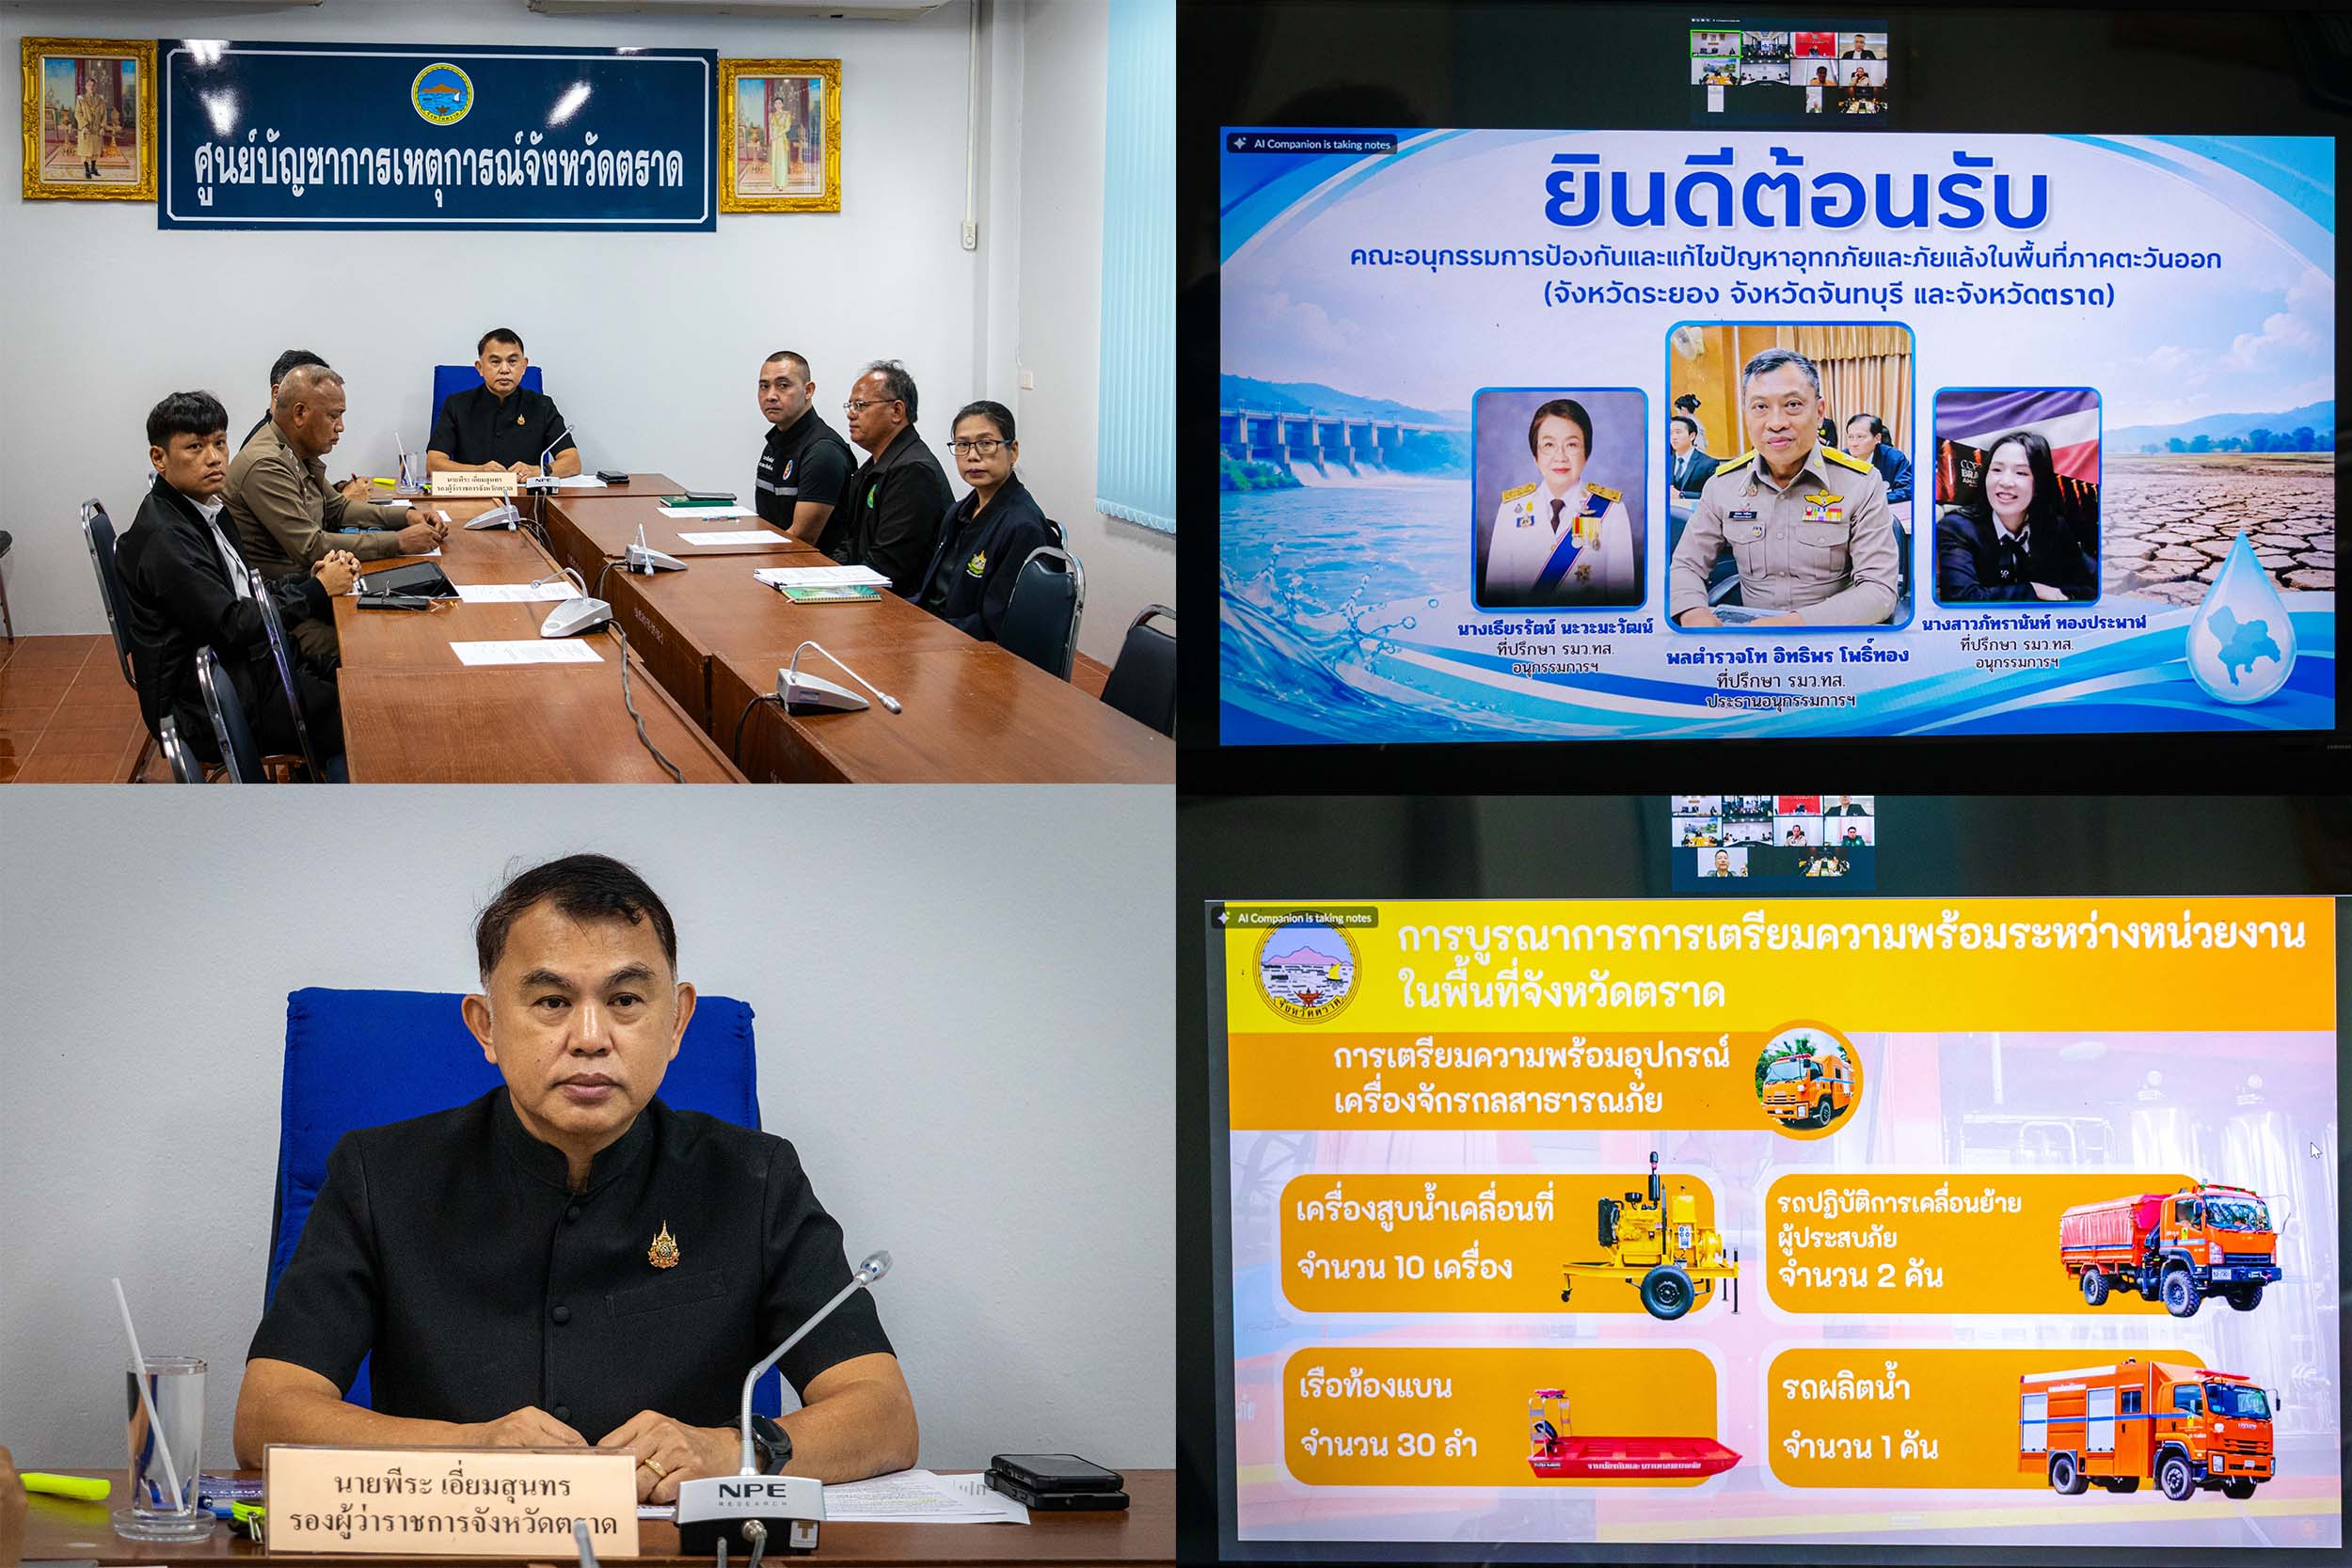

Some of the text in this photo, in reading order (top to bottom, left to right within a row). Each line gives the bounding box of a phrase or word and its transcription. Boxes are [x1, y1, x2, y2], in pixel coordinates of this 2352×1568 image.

[1254, 138, 1391, 152] AI Companion is taking notes
[195, 128, 682, 207] ศูนย์บัญชาการเหตุการณ์จังหวัดตราด
[1545, 147, 2049, 229] ยินดีต้อนรับ
[1351, 241, 2222, 275] คณะอนุกรรมการป้องกันและแก้ไขปัญหาอุทกภัยและภัยแล้งในพื้นที่ภาคตะวันออก
[1544, 280, 2115, 312] (จังหวัดระยอง จังหวัดจันทบุรี และจังหวัดตราด)
[1457, 617, 1654, 636] นางเธียรรัตน์ นะวะมะวัฒน์
[1922, 613, 2052, 631] นางสาวภัทรานันท์
[1496, 641, 1615, 657] ที่ปรึกษา รมว.ทส.
[1666, 638, 1909, 665] พลตำรวจโท อิทธิพร โพธิ์ทอง
[1961, 635, 2074, 651] ที่ปรึกษา รมว.ทส.
[1513, 660, 1598, 677] อนุกรรมการฯ
[1716, 669, 1846, 689] ที่ปรึกษา รมว.ทส.
[1976, 657, 2059, 673] อนุกรรมการฯ
[1707, 694, 1856, 713] ประธานอนุกรรมการฯ
[1237, 913, 1372, 925] AI Companion is taking notes
[1398, 911, 2306, 966] การบูรณาการการเตรียมความพร้อมระหว่างหน่วยงาน
[1398, 956, 1725, 1008] ในพื้นที่จังหวัดตราด
[1334, 1035, 1729, 1079] การเตรียมความพร้อมอุปกรณ์
[1335, 1074, 1663, 1114] เครื่องจักรกลสาธารณภัย
[1296, 1181, 1554, 1232] เครื่องสูบน้ำเคลื่อนที่
[1777, 1181, 2022, 1219] รถปฏิบัติการเคลื่อนย้าย
[1777, 1223, 1898, 1256] ผู้ประสบภัย
[1297, 1240, 1513, 1280] จำนวน 10 เครื่อง
[1778, 1258, 1944, 1288] จำนวน 2 คัน
[1299, 1366, 1453, 1399] เรือท้องแบน
[1782, 1361, 1911, 1401] รถผลิตน้ำ
[1300, 1428, 1477, 1457] จำนวน 30 ลำ
[1783, 1430, 1939, 1460] จำนวน 1 คัน
[334, 1461, 572, 1504] นายพีระ เอี่ยมสุนทร
[719, 1483, 787, 1498] NPE
